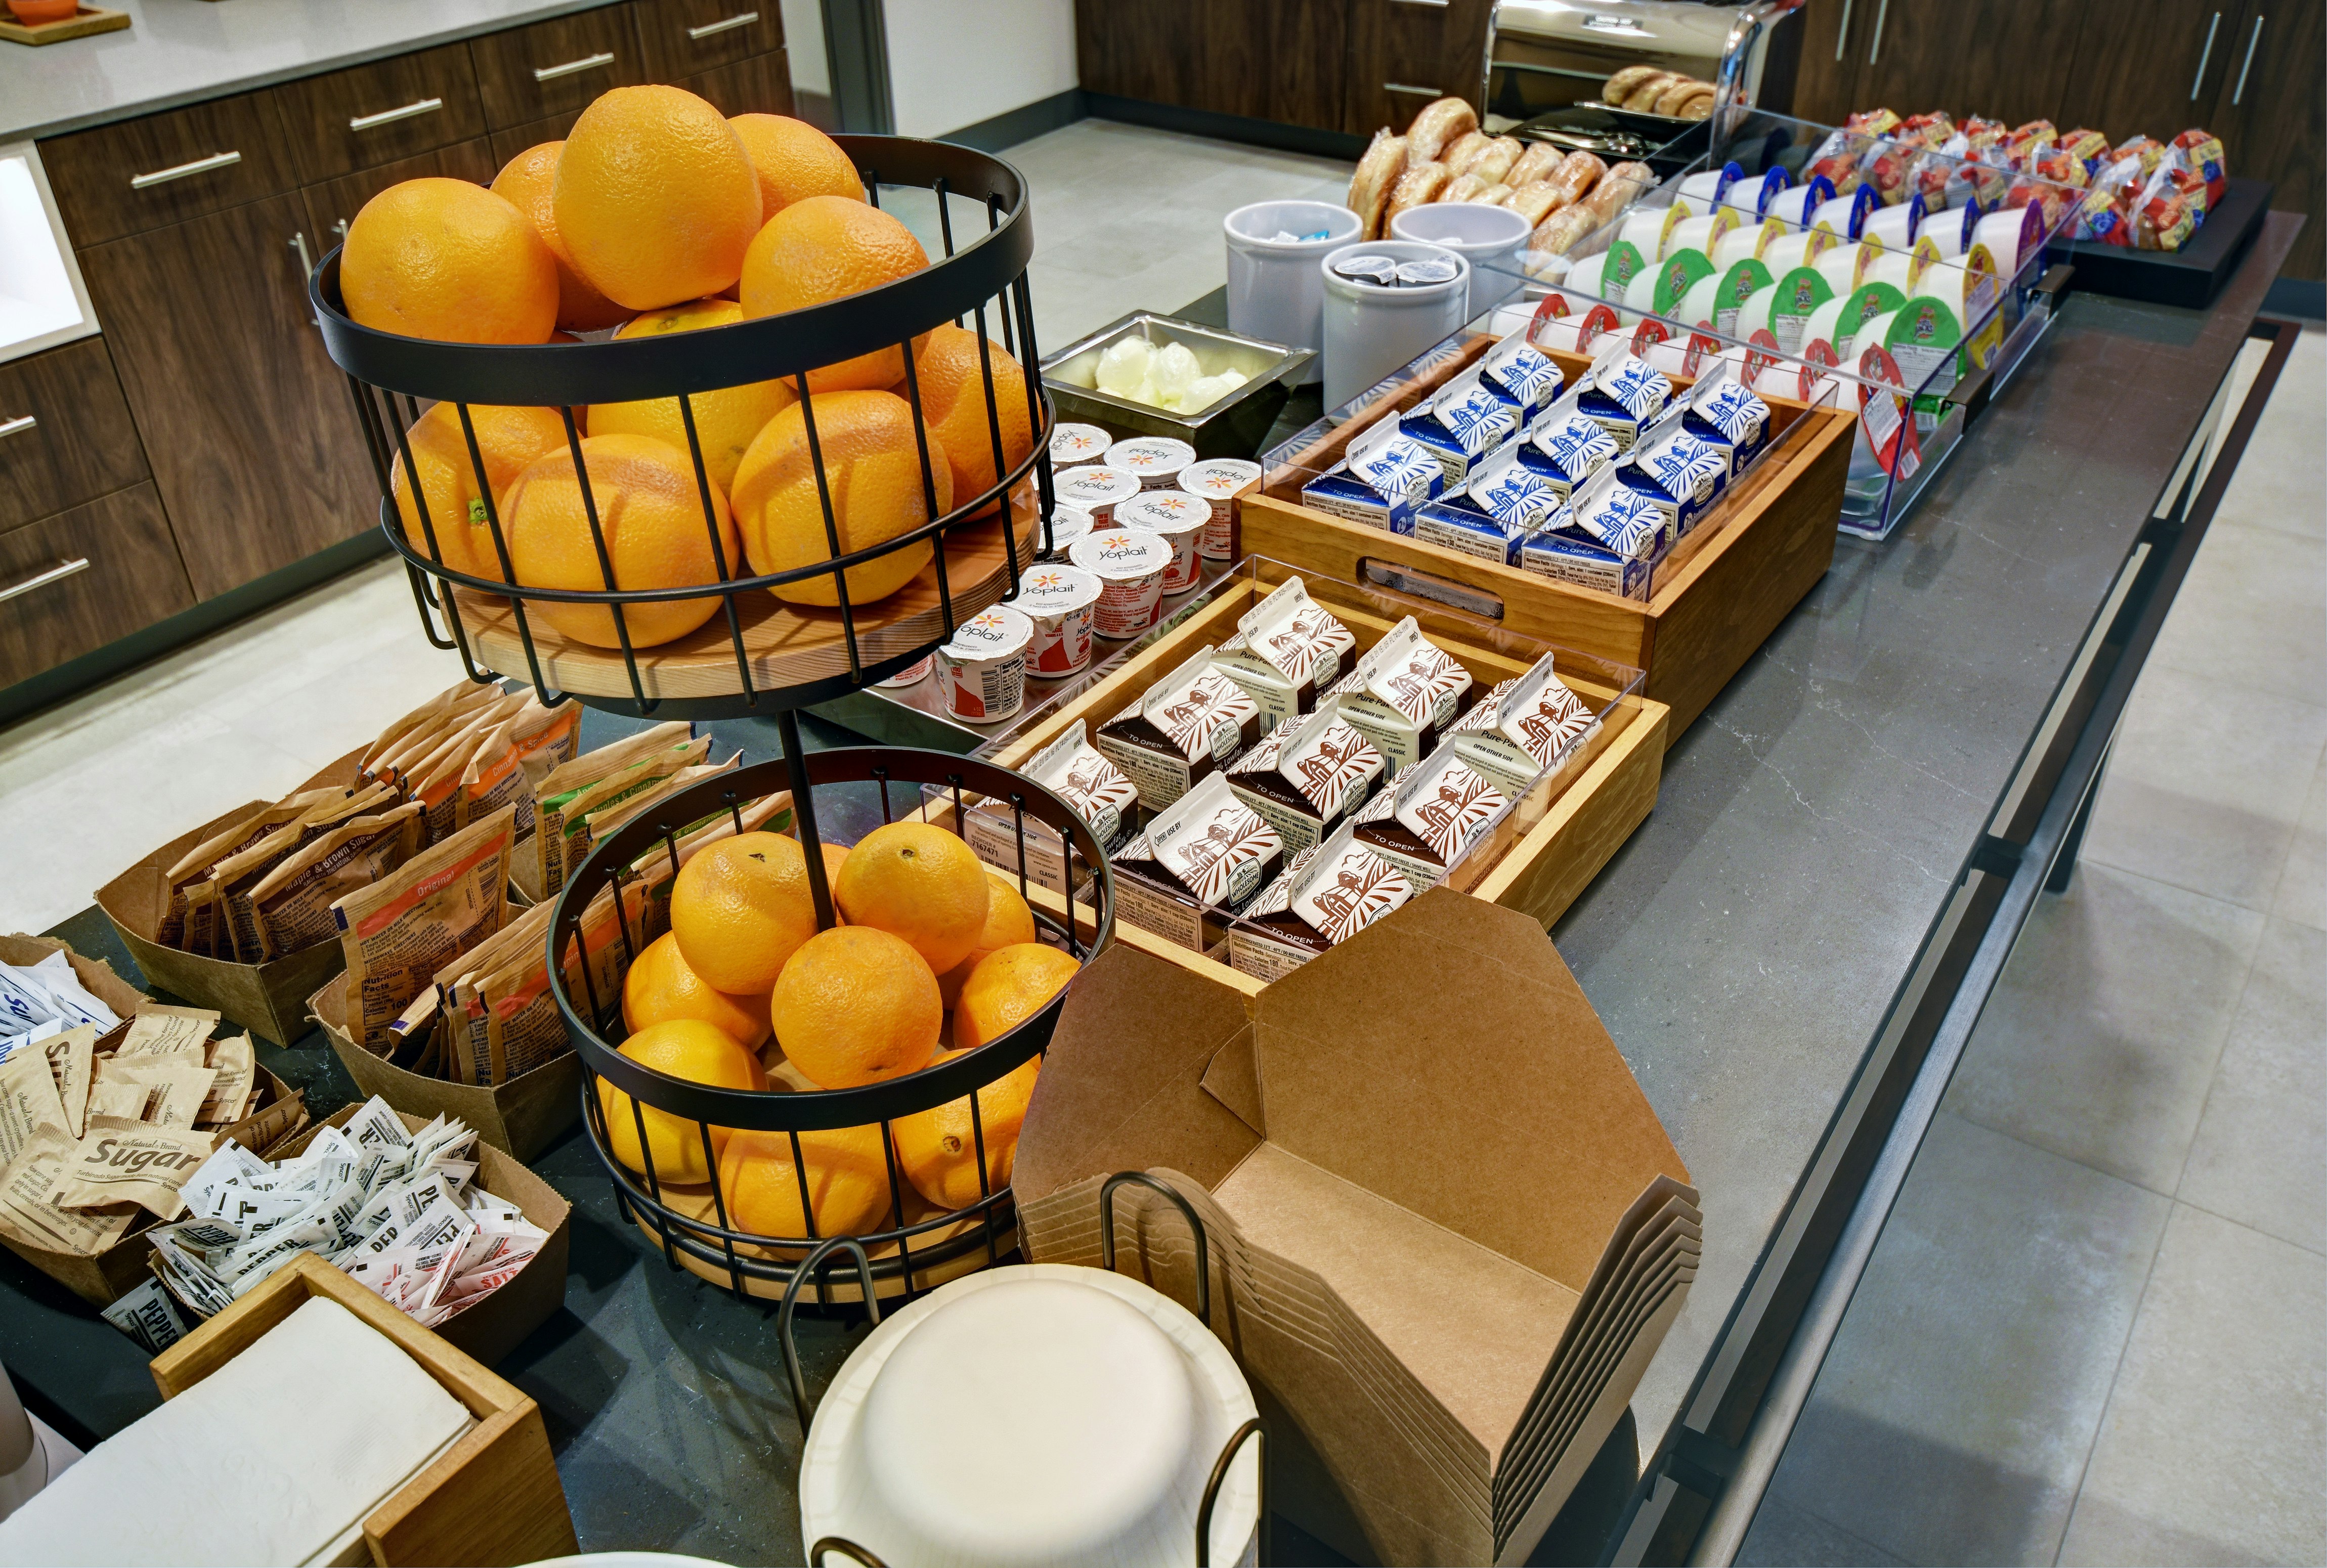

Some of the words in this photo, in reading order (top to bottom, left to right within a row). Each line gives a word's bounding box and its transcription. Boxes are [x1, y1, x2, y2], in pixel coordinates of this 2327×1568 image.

[1425, 436, 1446, 445] OPEN
[1129, 447, 1173, 459] Yoplait
[1206, 468, 1252, 483] Yoplait
[1069, 480, 1115, 491] Yoplait
[1137, 503, 1183, 520] Yoplait
[1099, 546, 1148, 560] Yoplait
[1023, 584, 1075, 596] Yoplait
[1244, 667, 1257, 675] OTHER
[1316, 661, 1338, 682] WHOLESOME
[1436, 703, 1456, 723] WHOLESOME
[1140, 739, 1163, 748] OPEN
[1214, 732, 1238, 755] WHOLESOME
[1224, 747, 1243, 767] Lowfat
[1388, 748, 1405, 756] CLASSIC
[1474, 744, 1486, 752] OPEN
[1487, 749, 1501, 758] OTHER
[1257, 785, 1267, 793] TO
[1269, 792, 1294, 803] OPEN
[1345, 787, 1366, 812] WHOLESOME
[971, 835, 992, 847] REORDER
[1115, 837, 1127, 850] Milk
[1374, 834, 1387, 843] TO
[1389, 840, 1414, 851] OPEN
[972, 840, 998, 857] 7167471
[285, 870, 312, 892] Maple
[323, 847, 350, 868] Brown
[350, 834, 375, 849] Sugar
[1040, 870, 1058, 880] CLASSIC
[417, 870, 454, 896] Original
[1232, 872, 1259, 899] WHOLESOME
[1242, 888, 1262, 907] Lowfat
[371, 931, 386, 941] WATER
[394, 918, 403, 927] MILK
[403, 902, 426, 919] DIRECTIONS
[1234, 941, 1252, 951] Nutrition
[1240, 936, 1263, 947] REFRIGERATED
[1286, 934, 1313, 945] OPEN
[1255, 955, 1269, 965] Calories
[1270, 960, 1278, 968] 180
[1296, 953, 1307, 962] FREEZE
[364, 969, 403, 984] Nutrition
[364, 983, 389, 992] Facts
[365, 1005, 387, 1014] Calories
[392, 998, 408, 1011] 100
[512, 1013, 526, 1024] WATER
[18, 1093, 32, 1114] Natural
[25, 1117, 35, 1135] Brand
[122, 1140, 156, 1149] Natural
[160, 1142, 183, 1151] Brand
[84, 1139, 202, 1173] Sugar
[77, 1169, 105, 1179] Turbinado
[148, 1173, 169, 1182] natural
[161, 1182, 178, 1192] Sysco
[405, 1194, 414, 1208] Sysco
[45, 1209, 68, 1227] beverages.
[367, 1218, 380, 1226] Sysco
[439, 1214, 451, 1227] Sysco
[82, 1223, 102, 1237] favorite
[481, 1270, 519, 1288] SALT
[126, 1313, 135, 1326] Sysco
